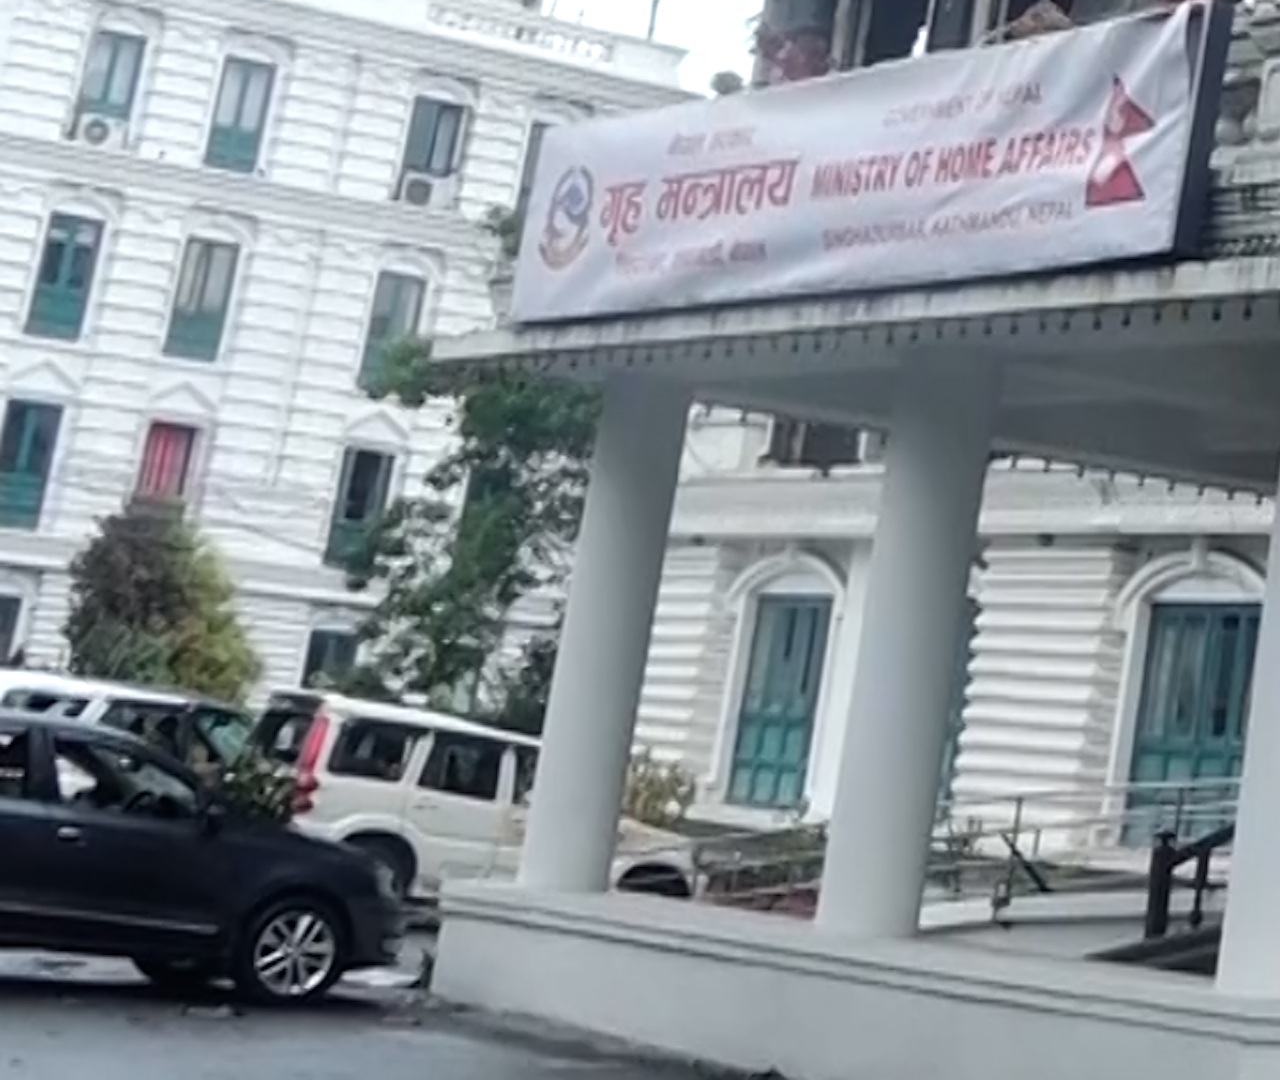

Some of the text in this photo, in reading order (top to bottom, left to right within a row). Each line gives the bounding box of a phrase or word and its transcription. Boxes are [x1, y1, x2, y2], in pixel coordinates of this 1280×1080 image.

[599, 152, 802, 248] गृह मन्त्रालय
[809, 126, 1097, 201] MINISTRY OF HOME AFFAIRS
